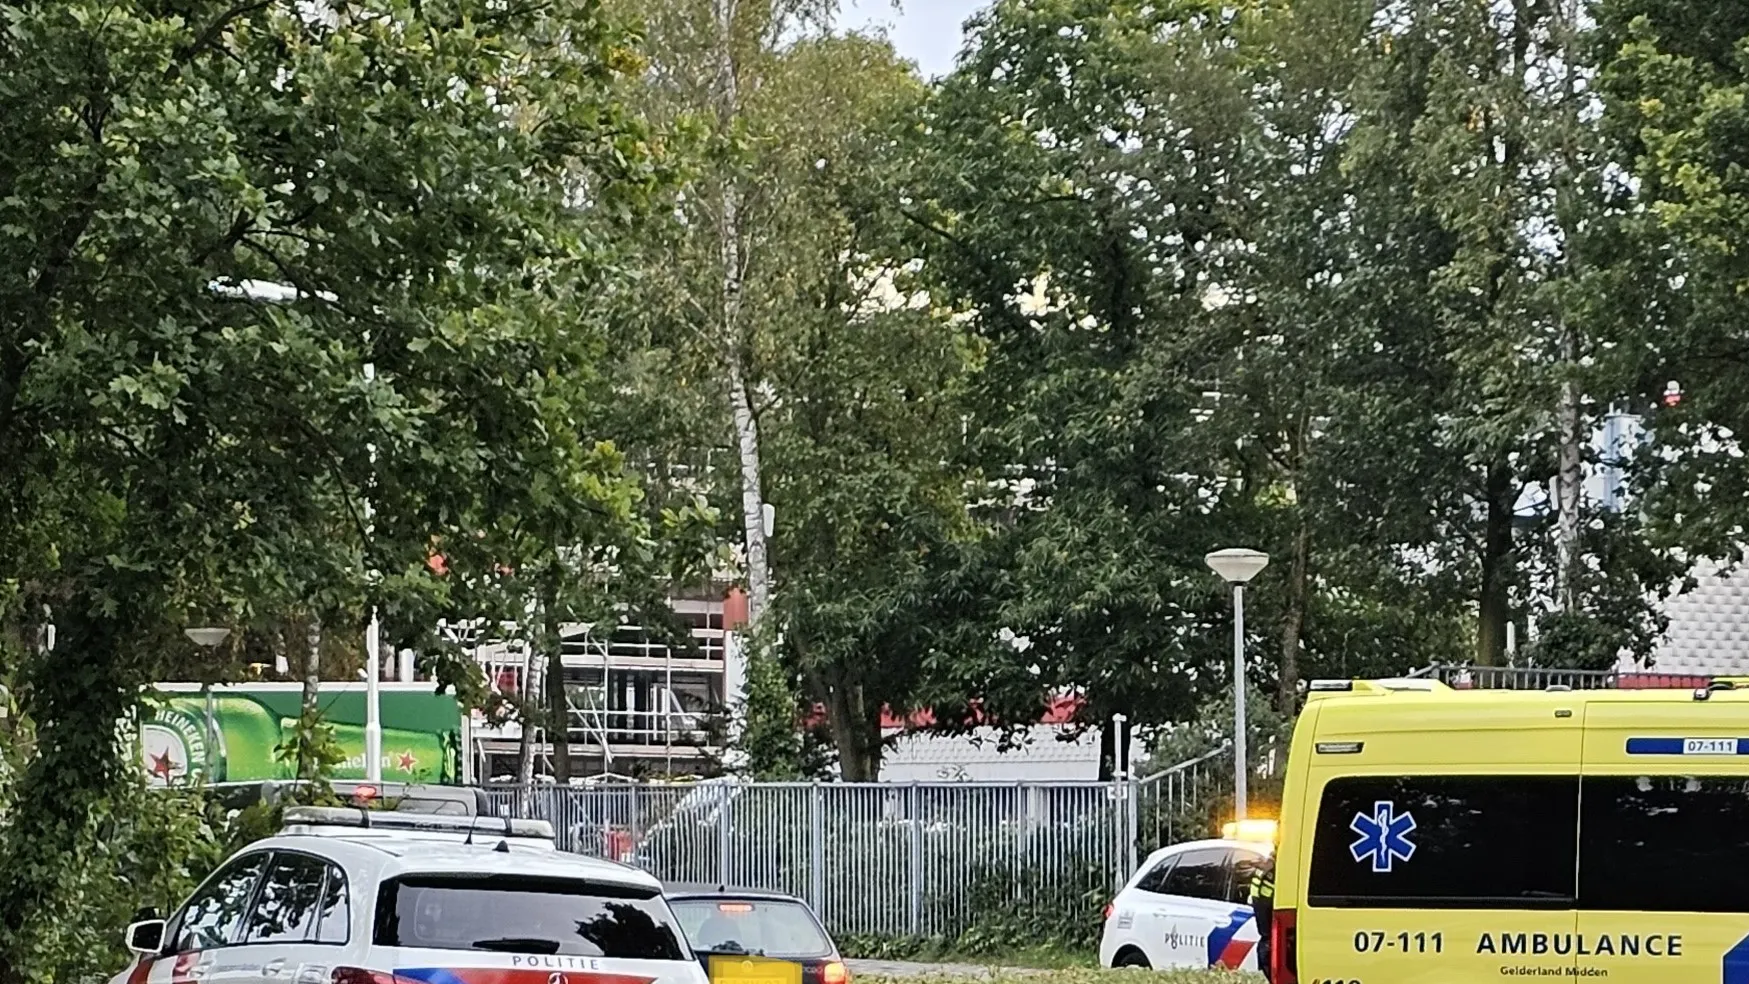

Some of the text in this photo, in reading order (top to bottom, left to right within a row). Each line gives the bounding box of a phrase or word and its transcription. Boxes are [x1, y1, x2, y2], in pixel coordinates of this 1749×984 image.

[1688, 741, 1733, 752] 07-111
[1354, 931, 1683, 957] 07-111 AMBULANCE
[512, 956, 600, 970] POLITIE
[1500, 965, 1608, 978] Gelderland Midden
